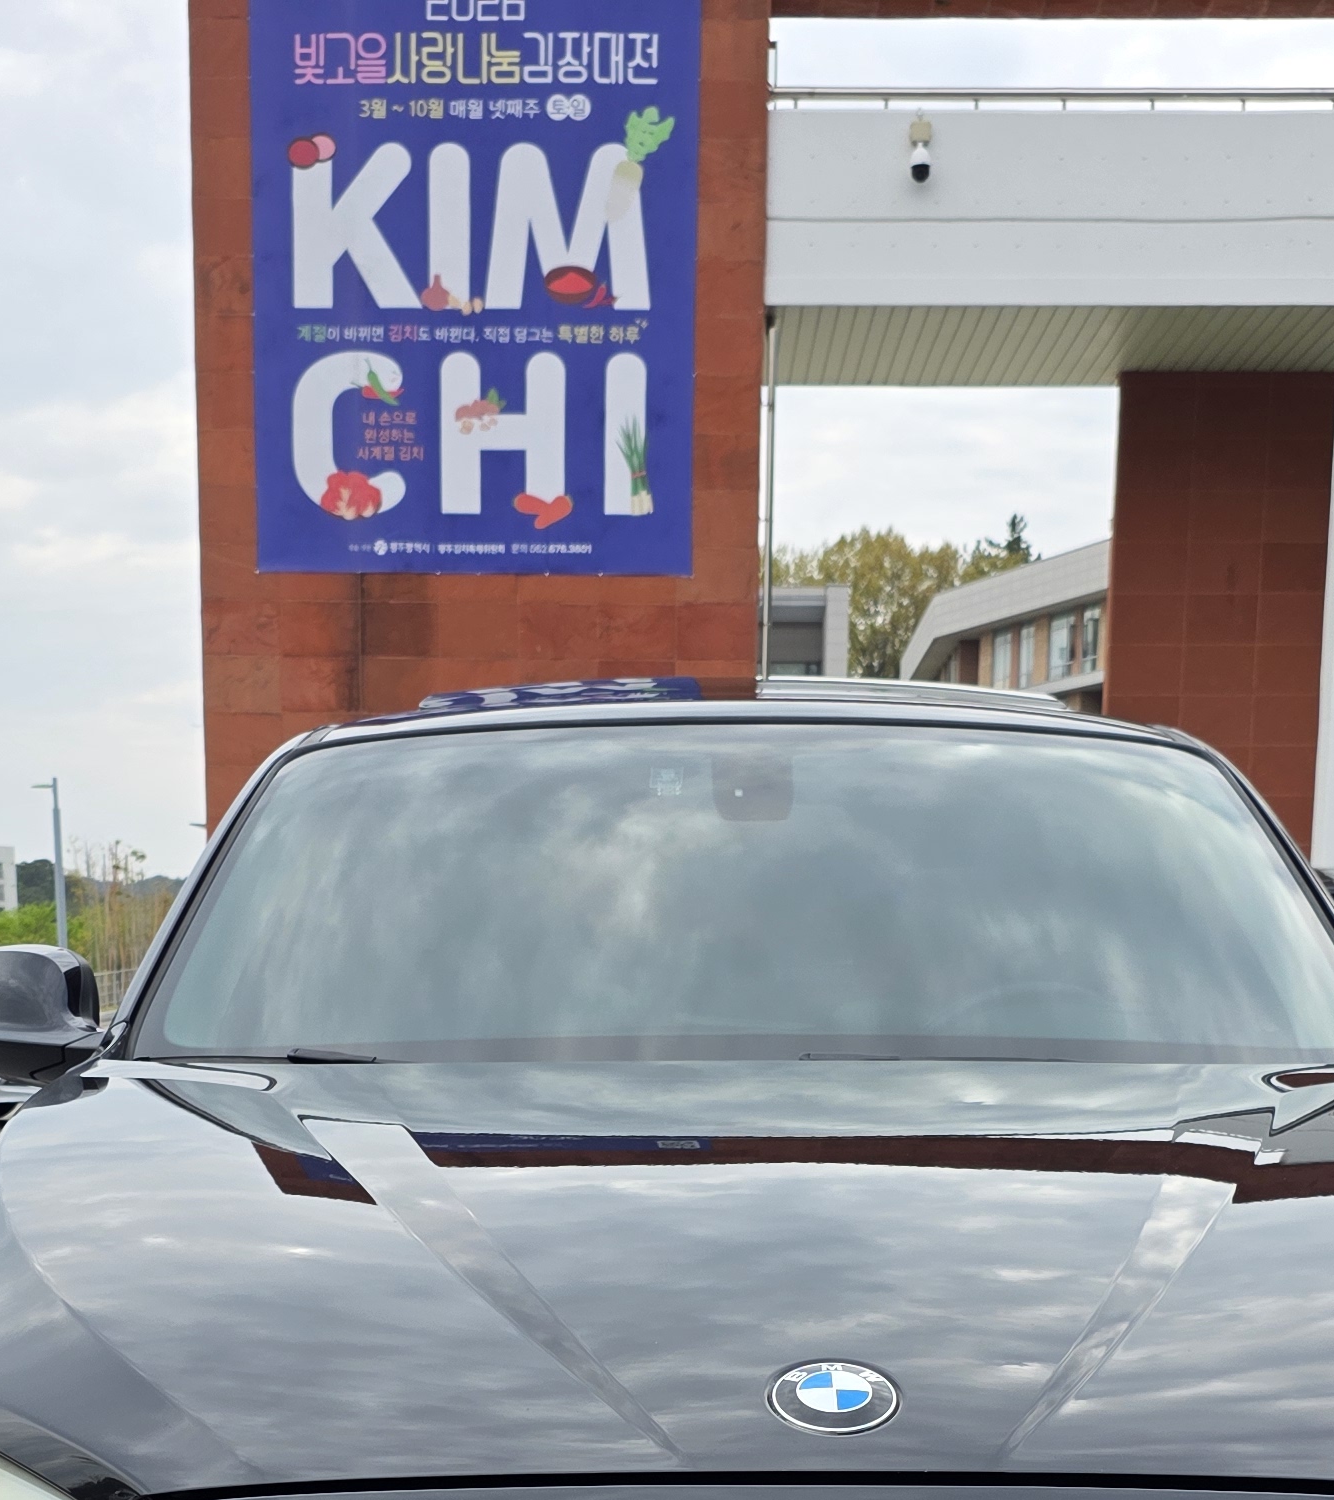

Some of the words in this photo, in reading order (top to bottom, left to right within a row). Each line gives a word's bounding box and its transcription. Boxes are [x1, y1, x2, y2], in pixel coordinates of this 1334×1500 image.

[359, 99, 387, 120] 3월
[409, 99, 444, 119] 10월
[449, 99, 483, 119] 매월
[488, 99, 541, 119] 넷째주
[292, 142, 651, 310] KIM
[297, 323, 340, 343] 계절이
[344, 325, 384, 343] 바뀌면
[388, 323, 432, 343] 김치도
[483, 326, 510, 344] 직접
[557, 323, 605, 344] 특별한
[608, 325, 641, 344] 하루
[362, 411, 375, 426] 내
[292, 351, 650, 515] CHI
[399, 446, 424, 461] 김치
